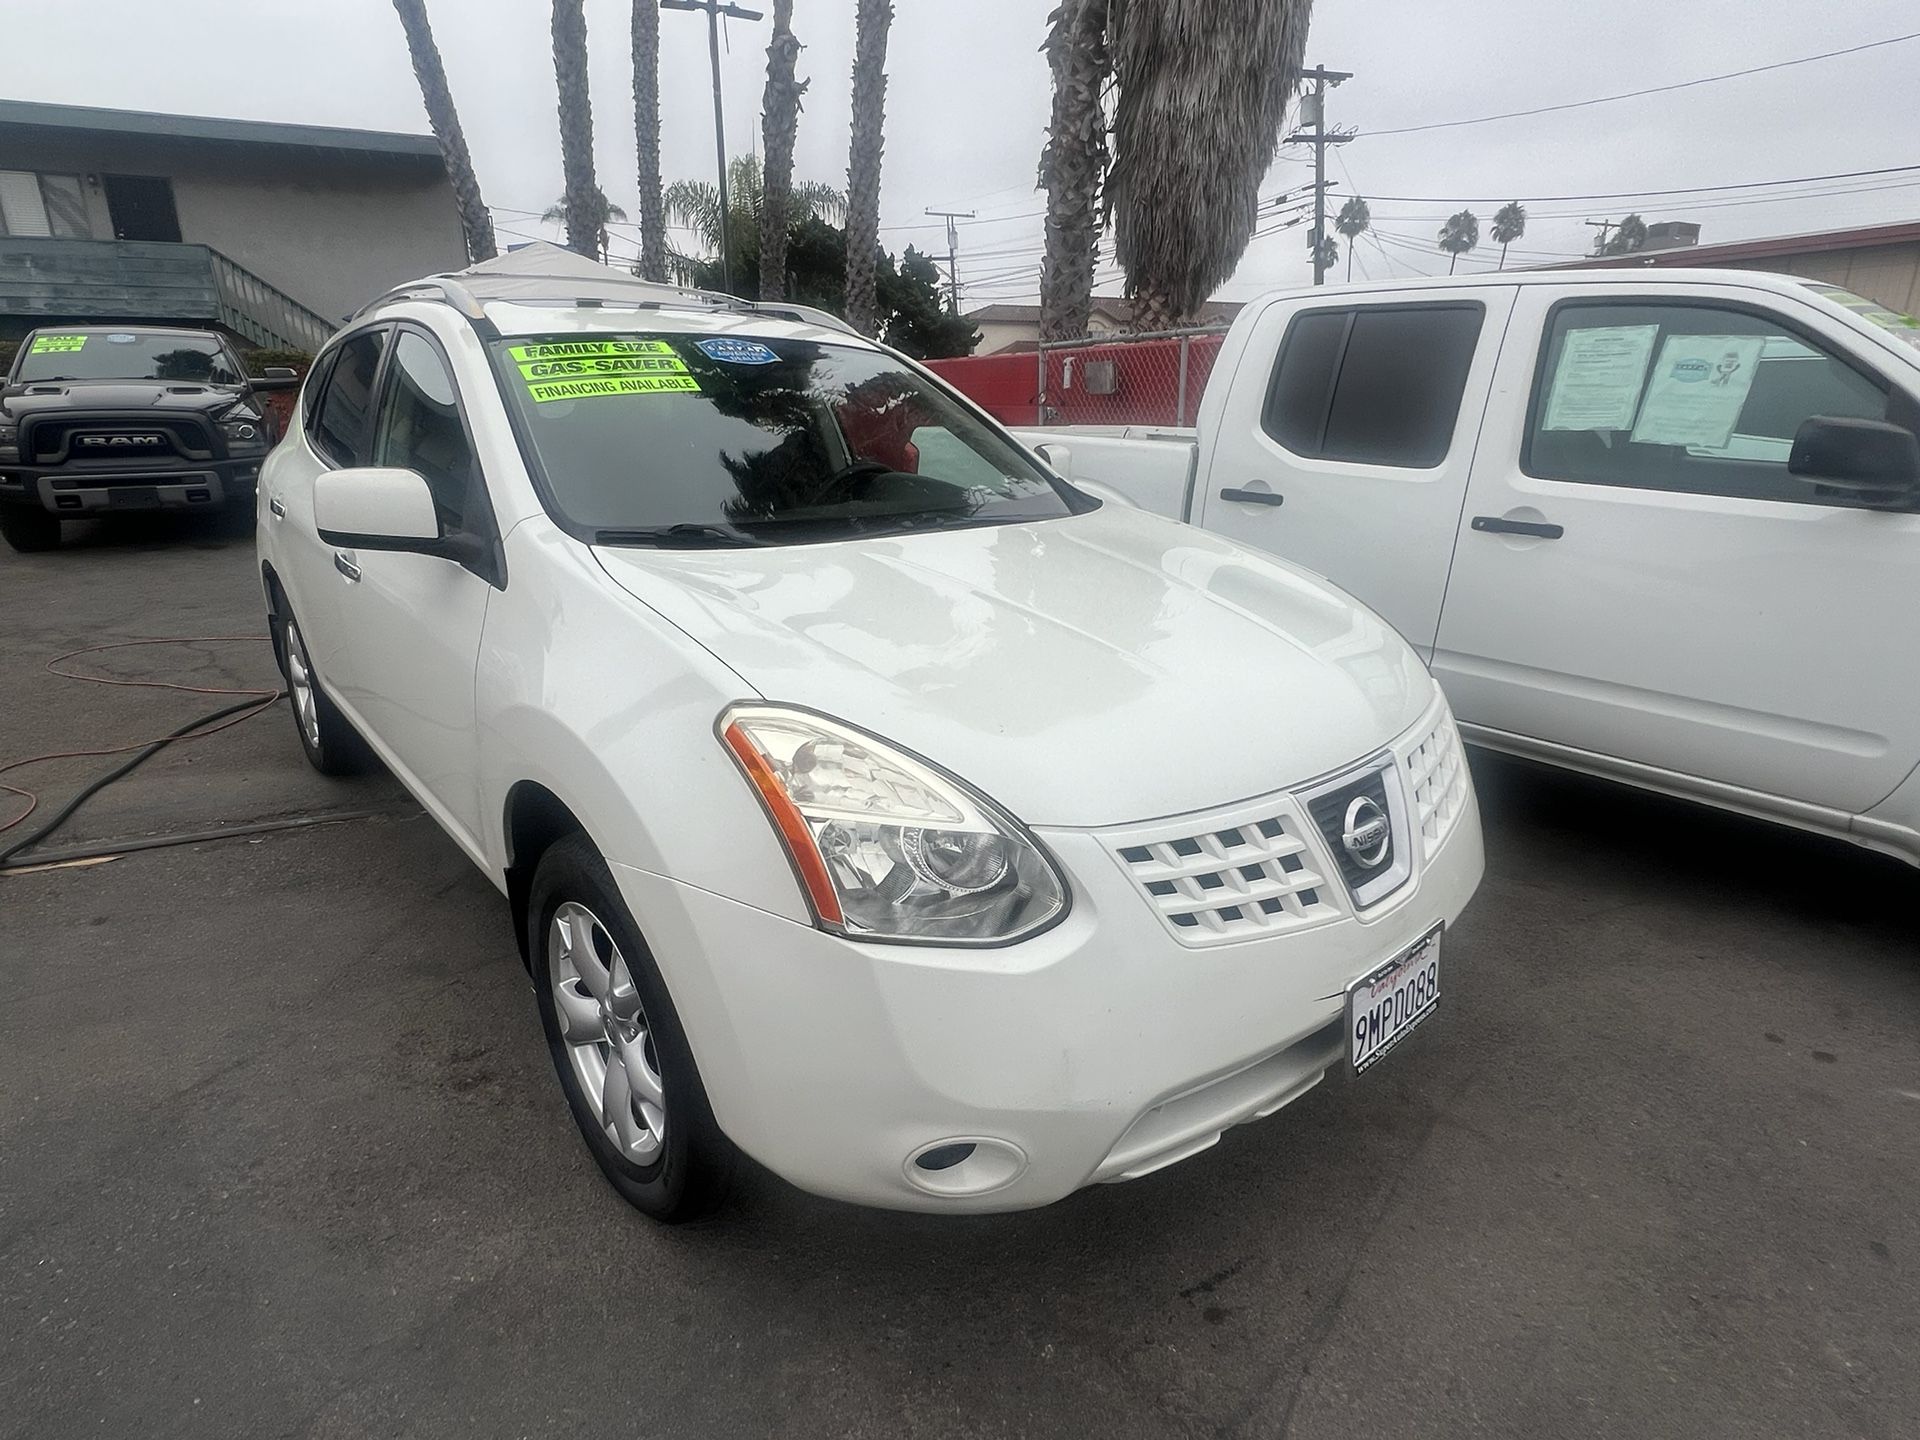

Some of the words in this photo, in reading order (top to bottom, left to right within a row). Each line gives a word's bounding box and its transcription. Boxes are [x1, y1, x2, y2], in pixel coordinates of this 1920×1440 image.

[525, 343, 608, 358] FAMILY
[612, 342, 663, 354] SIZE
[531, 359, 677, 377] GAS-SAVER
[535, 382, 617, 399] FINANCING
[620, 378, 695, 392] AVAILABLE
[83, 437, 158, 446] RAM
[1356, 962, 1437, 1062] 9MPD088
